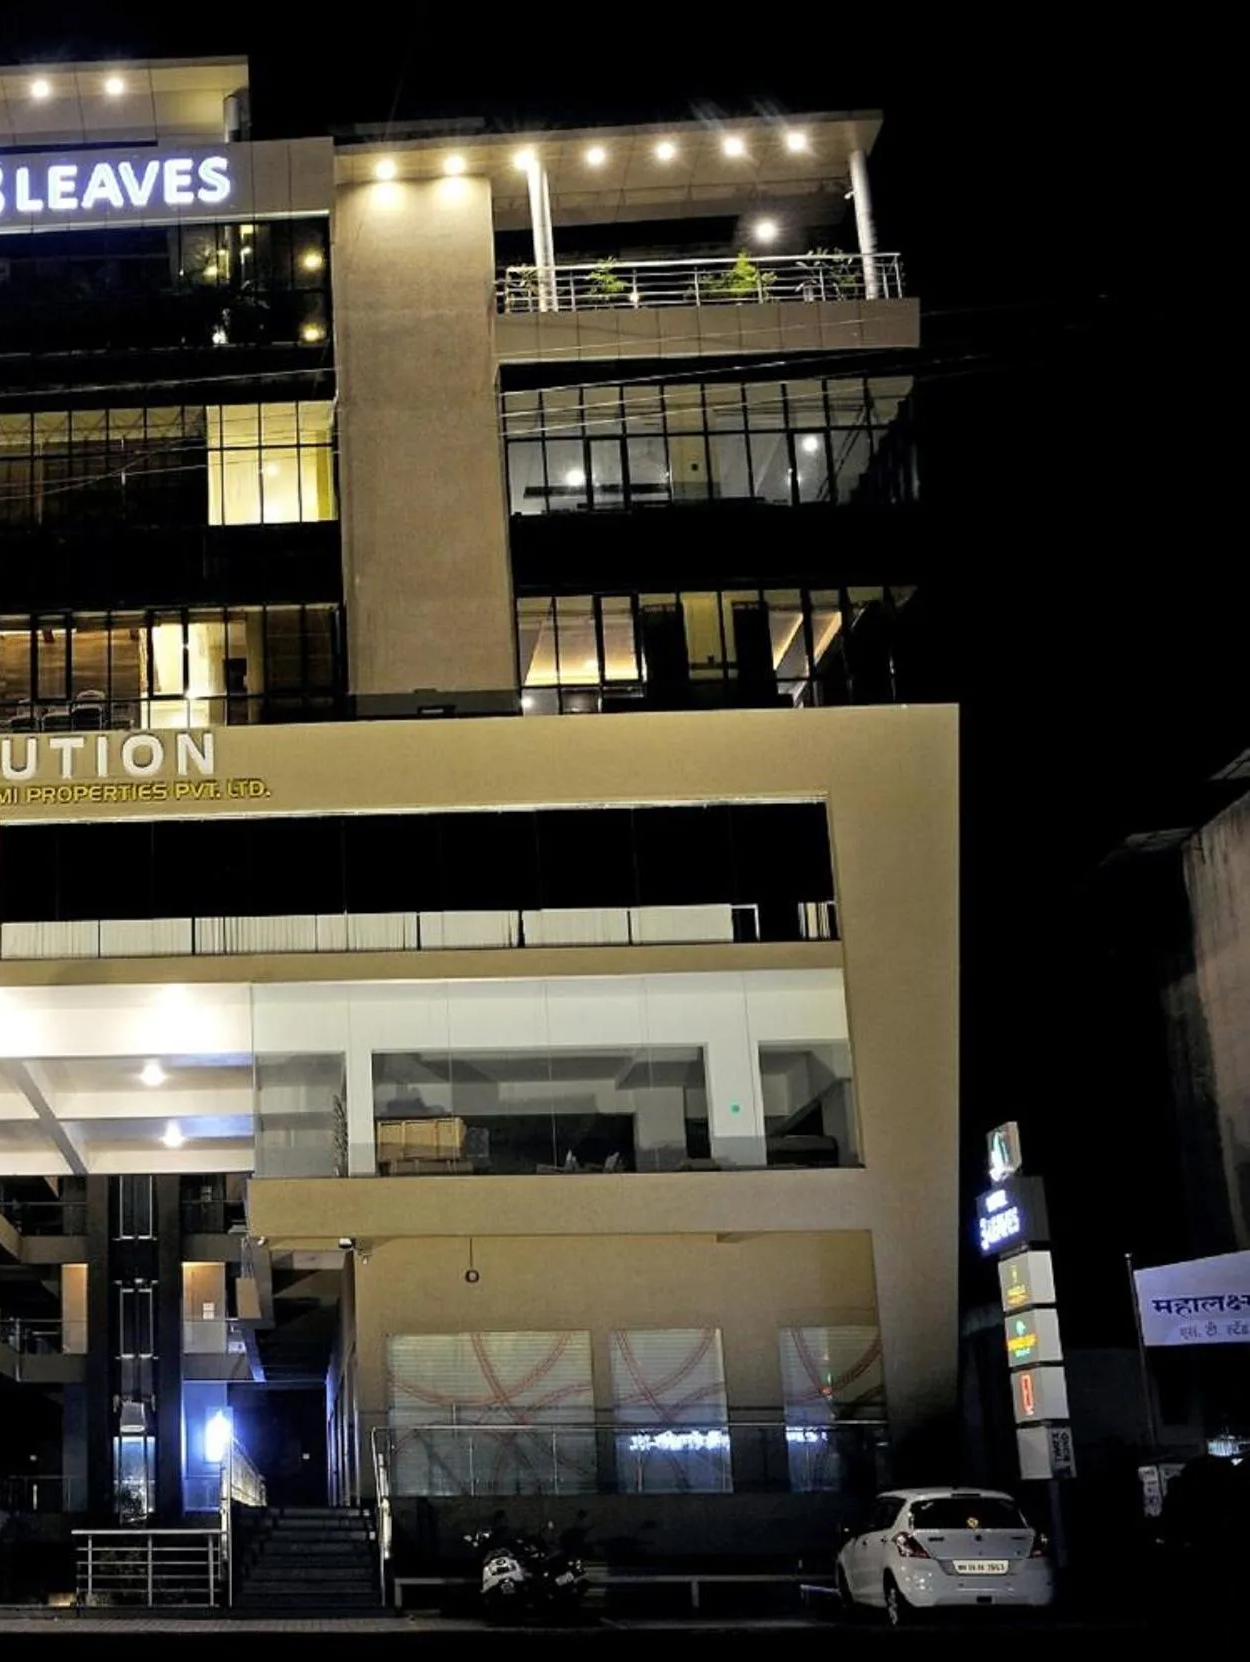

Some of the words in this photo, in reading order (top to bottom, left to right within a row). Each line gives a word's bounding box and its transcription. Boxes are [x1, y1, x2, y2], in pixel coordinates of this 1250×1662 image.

[15, 157, 232, 212] LEAVES
[26, 784, 168, 804] PROPERTIES
[175, 783, 222, 801] PVT.
[227, 780, 272, 798] LTD.
